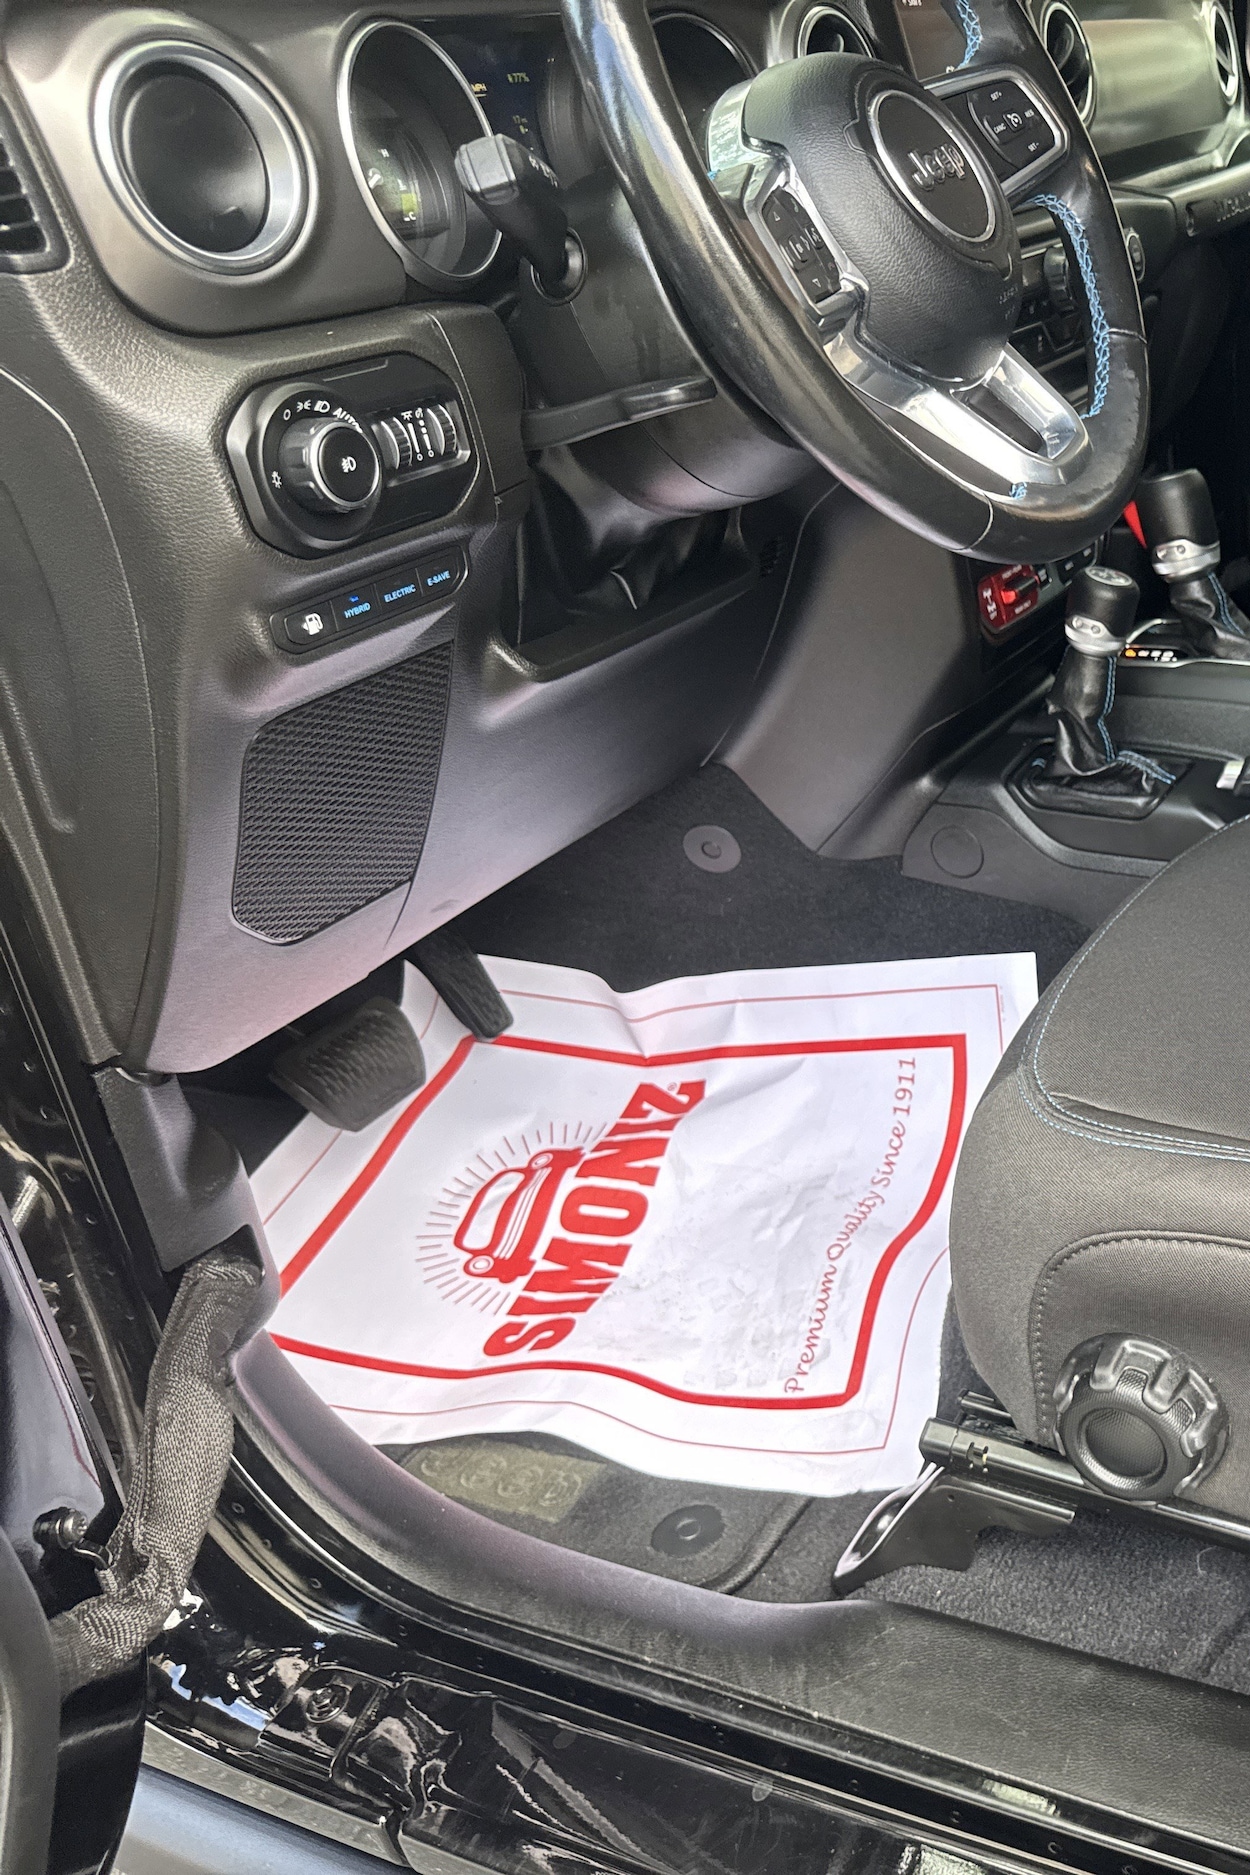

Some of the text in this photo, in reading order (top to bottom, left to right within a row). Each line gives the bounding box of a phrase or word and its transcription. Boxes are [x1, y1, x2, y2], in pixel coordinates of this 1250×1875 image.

[908, 143, 965, 191] Jeep
[384, 584, 416, 603] ELECTRIC
[427, 570, 450, 587] E-SAVE
[344, 602, 371, 619] HYBRID
[482, 1078, 707, 1357] SIMONIZ
[784, 1056, 917, 1394] Premium Quality Since 1911
